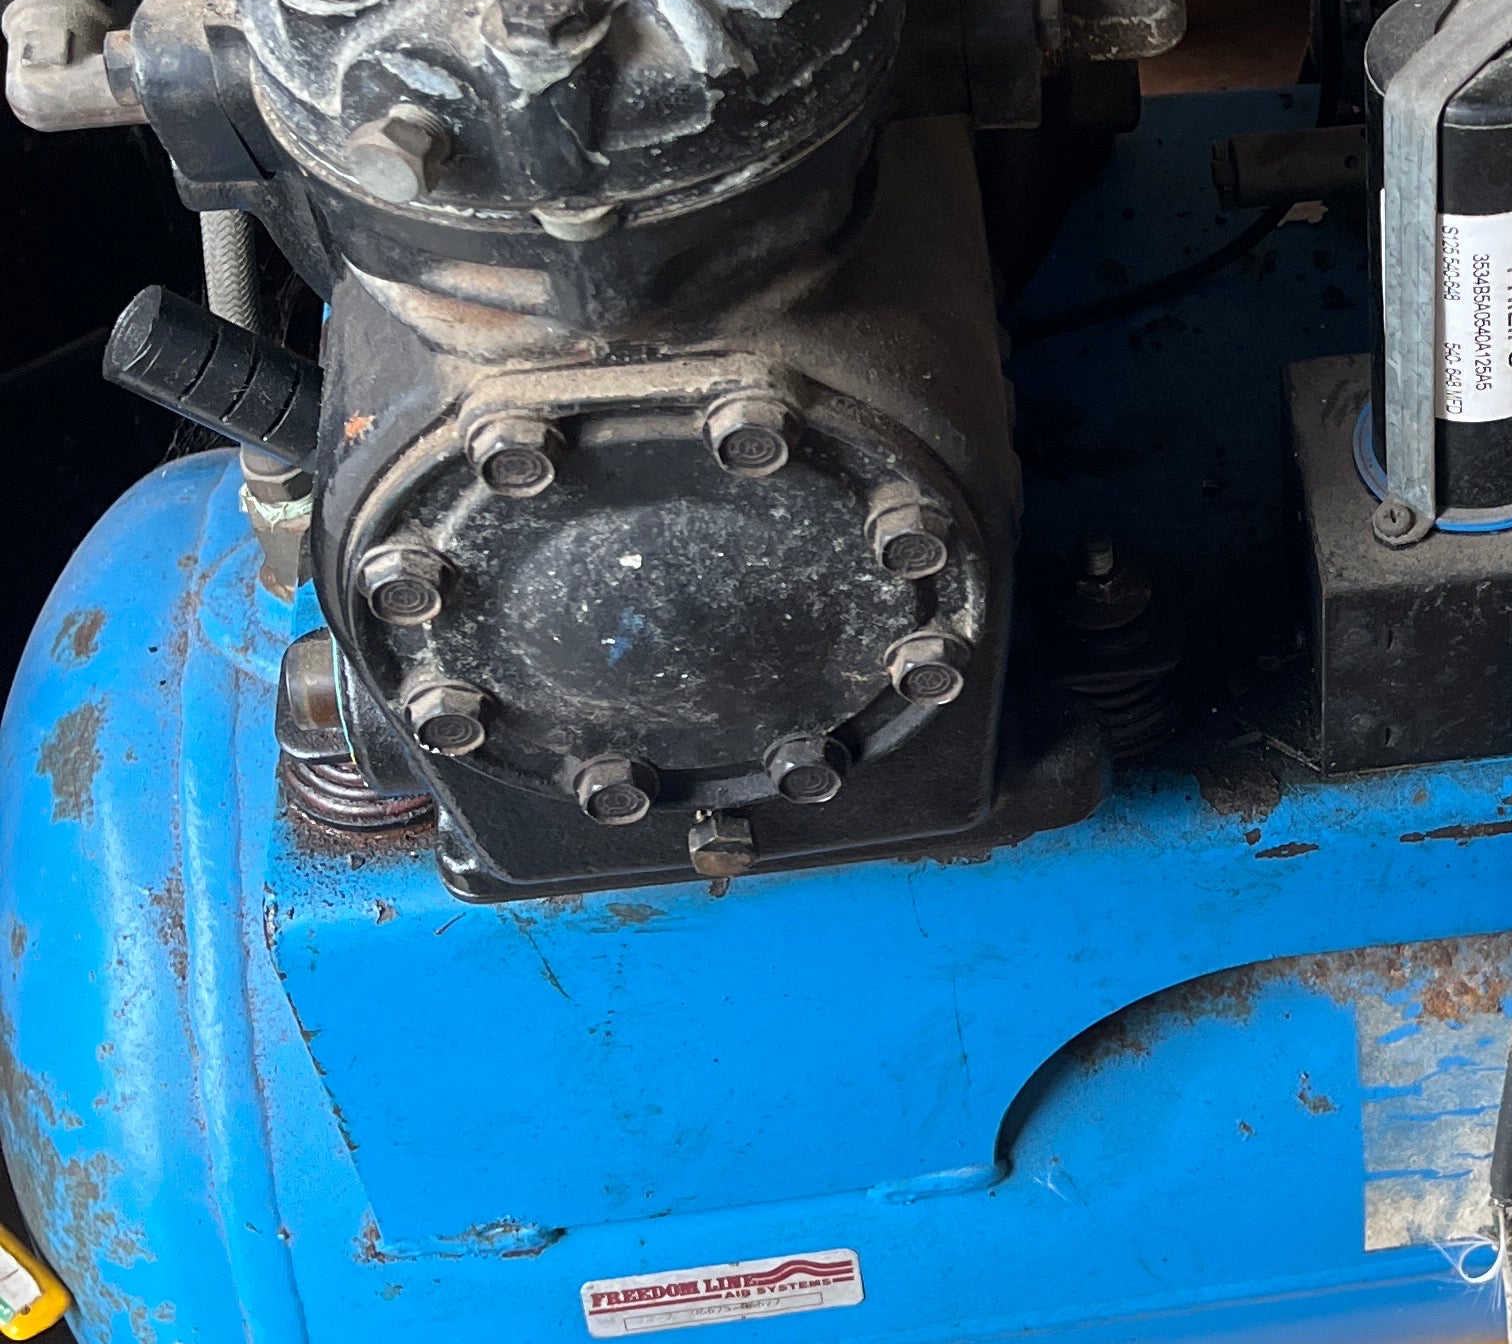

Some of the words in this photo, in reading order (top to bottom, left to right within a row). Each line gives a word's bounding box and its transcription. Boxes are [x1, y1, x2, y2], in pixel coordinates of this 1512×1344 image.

[1442, 225, 1460, 255] S125
[1443, 255, 1461, 302] 540-648
[1472, 253, 1492, 392] 3534B5A0540A125A5
[1445, 366, 1462, 388] 648
[1446, 388, 1463, 415] MFD
[591, 1280, 700, 1307] FREEDOM
[704, 1273, 759, 1294] LINE
[757, 1278, 832, 1294] SYSTEMS
